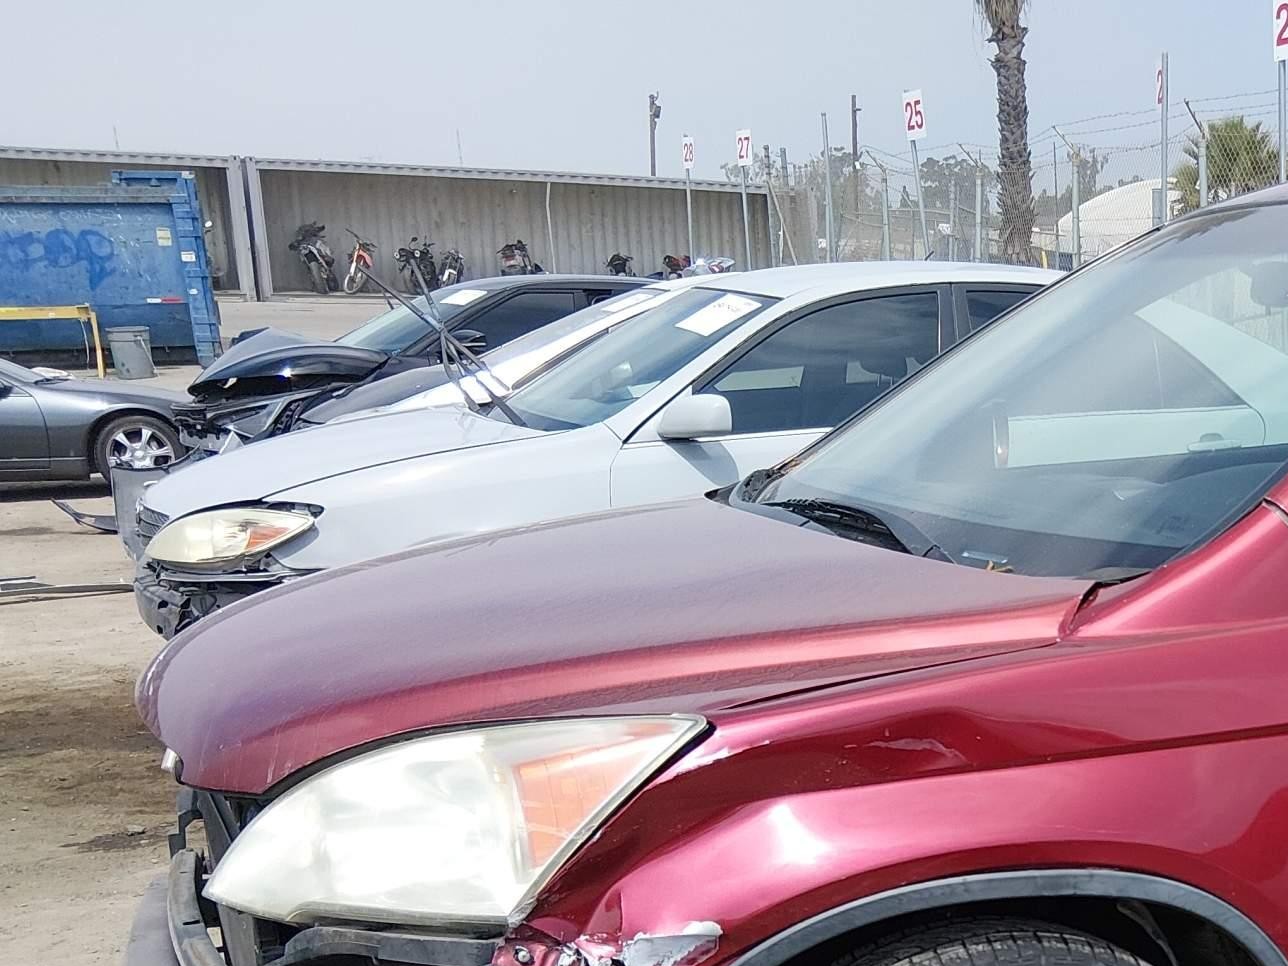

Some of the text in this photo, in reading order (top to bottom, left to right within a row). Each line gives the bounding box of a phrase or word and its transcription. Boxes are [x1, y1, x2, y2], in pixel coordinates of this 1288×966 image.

[905, 100, 924, 131] 25
[683, 143, 694, 162] 28
[737, 136, 750, 159] 27
